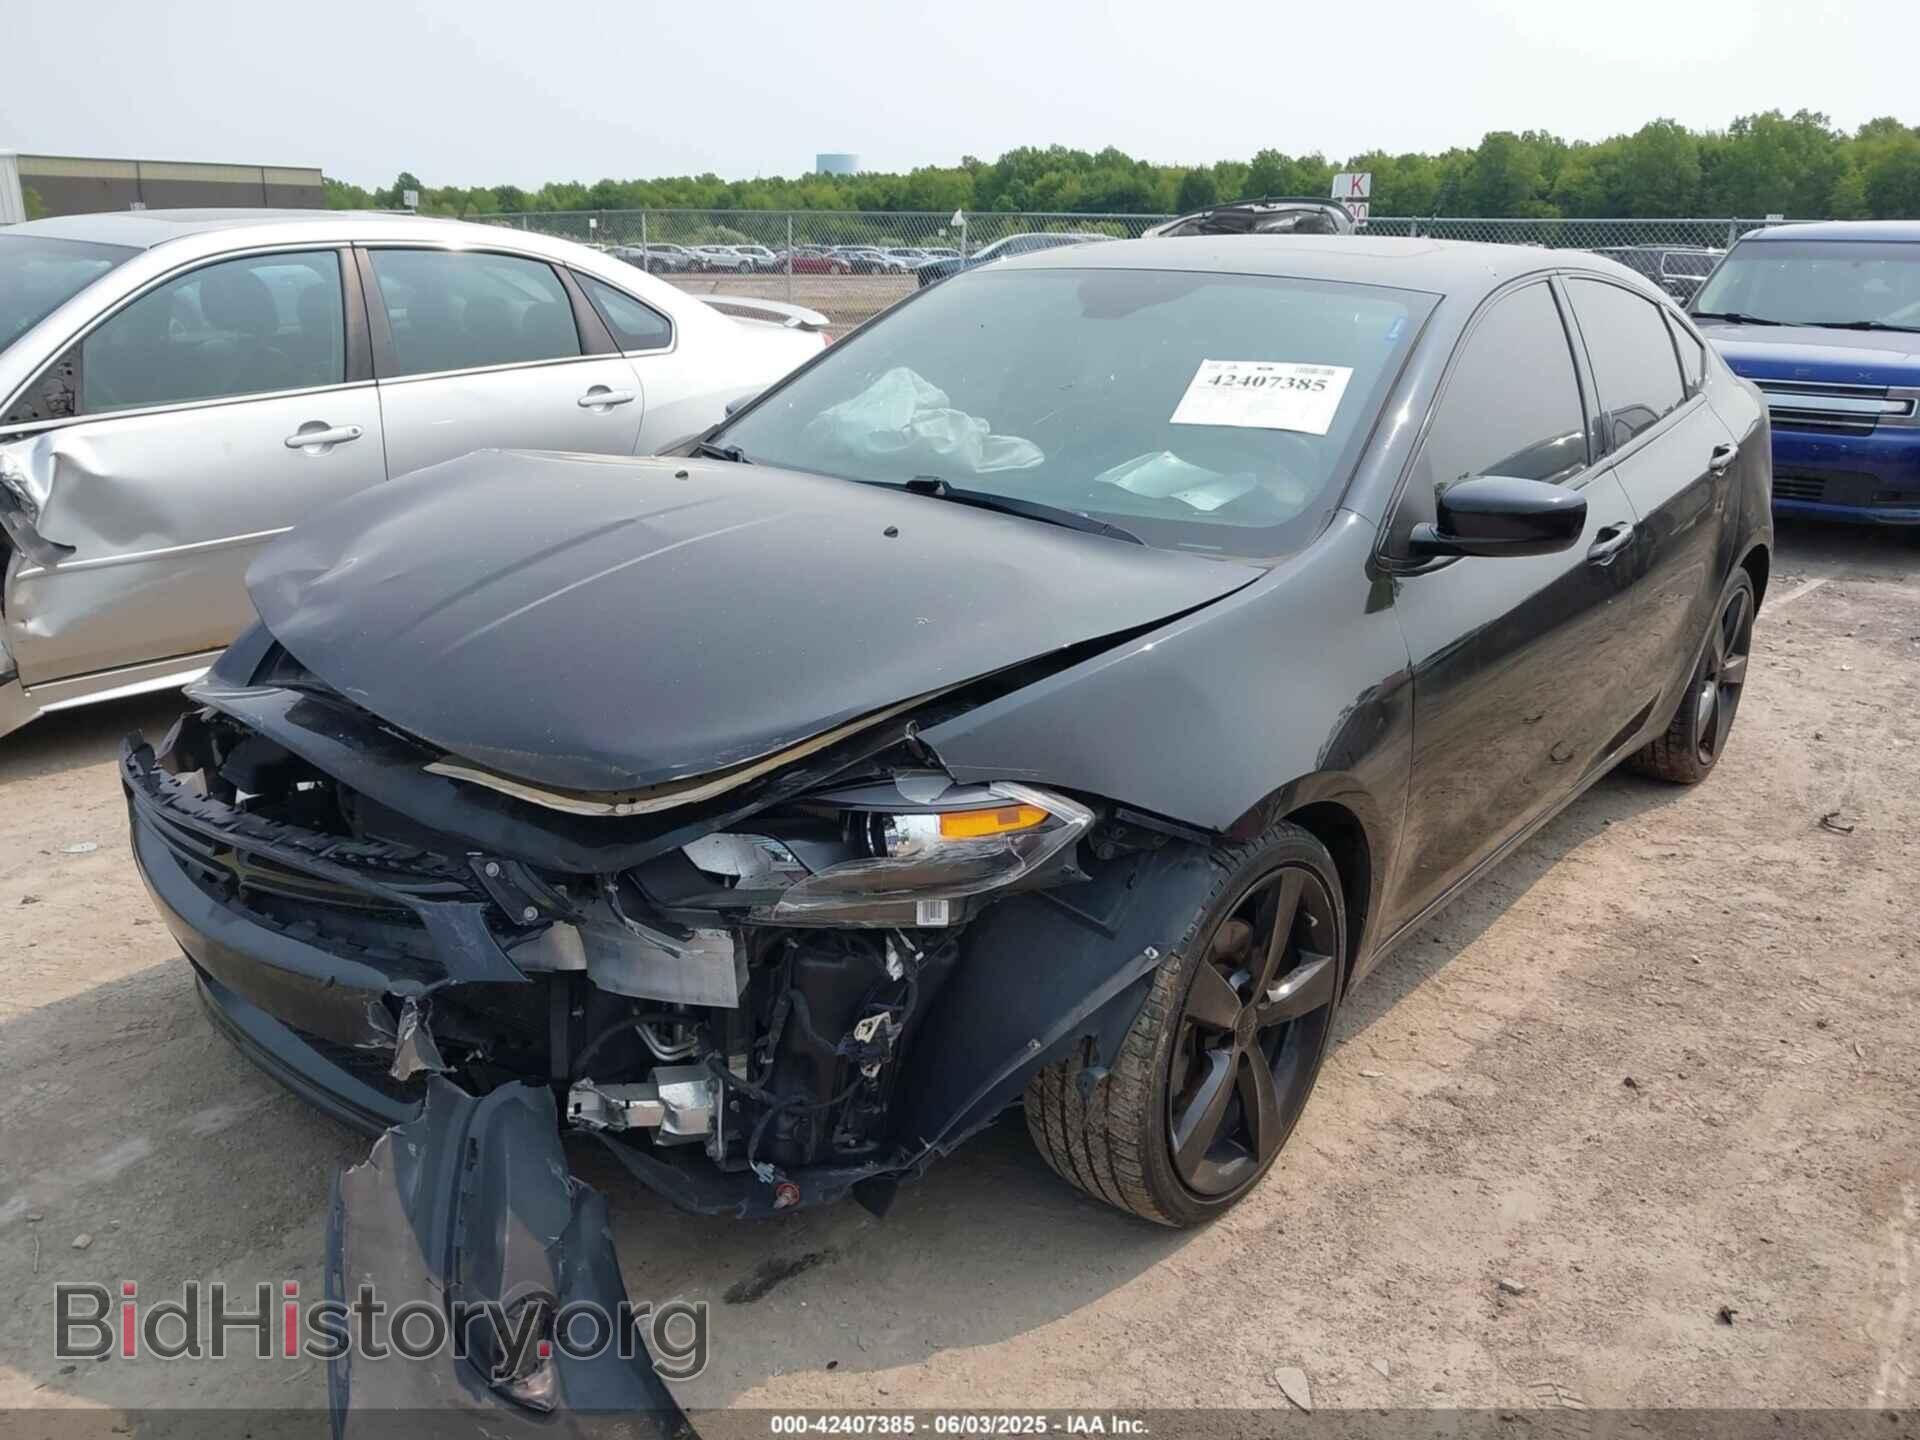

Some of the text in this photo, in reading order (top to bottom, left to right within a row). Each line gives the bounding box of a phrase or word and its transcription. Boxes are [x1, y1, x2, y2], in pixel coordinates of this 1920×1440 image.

[1351, 174, 1365, 196] K
[1735, 364, 1874, 381] LEX
[1207, 373, 1329, 393] 42407385
